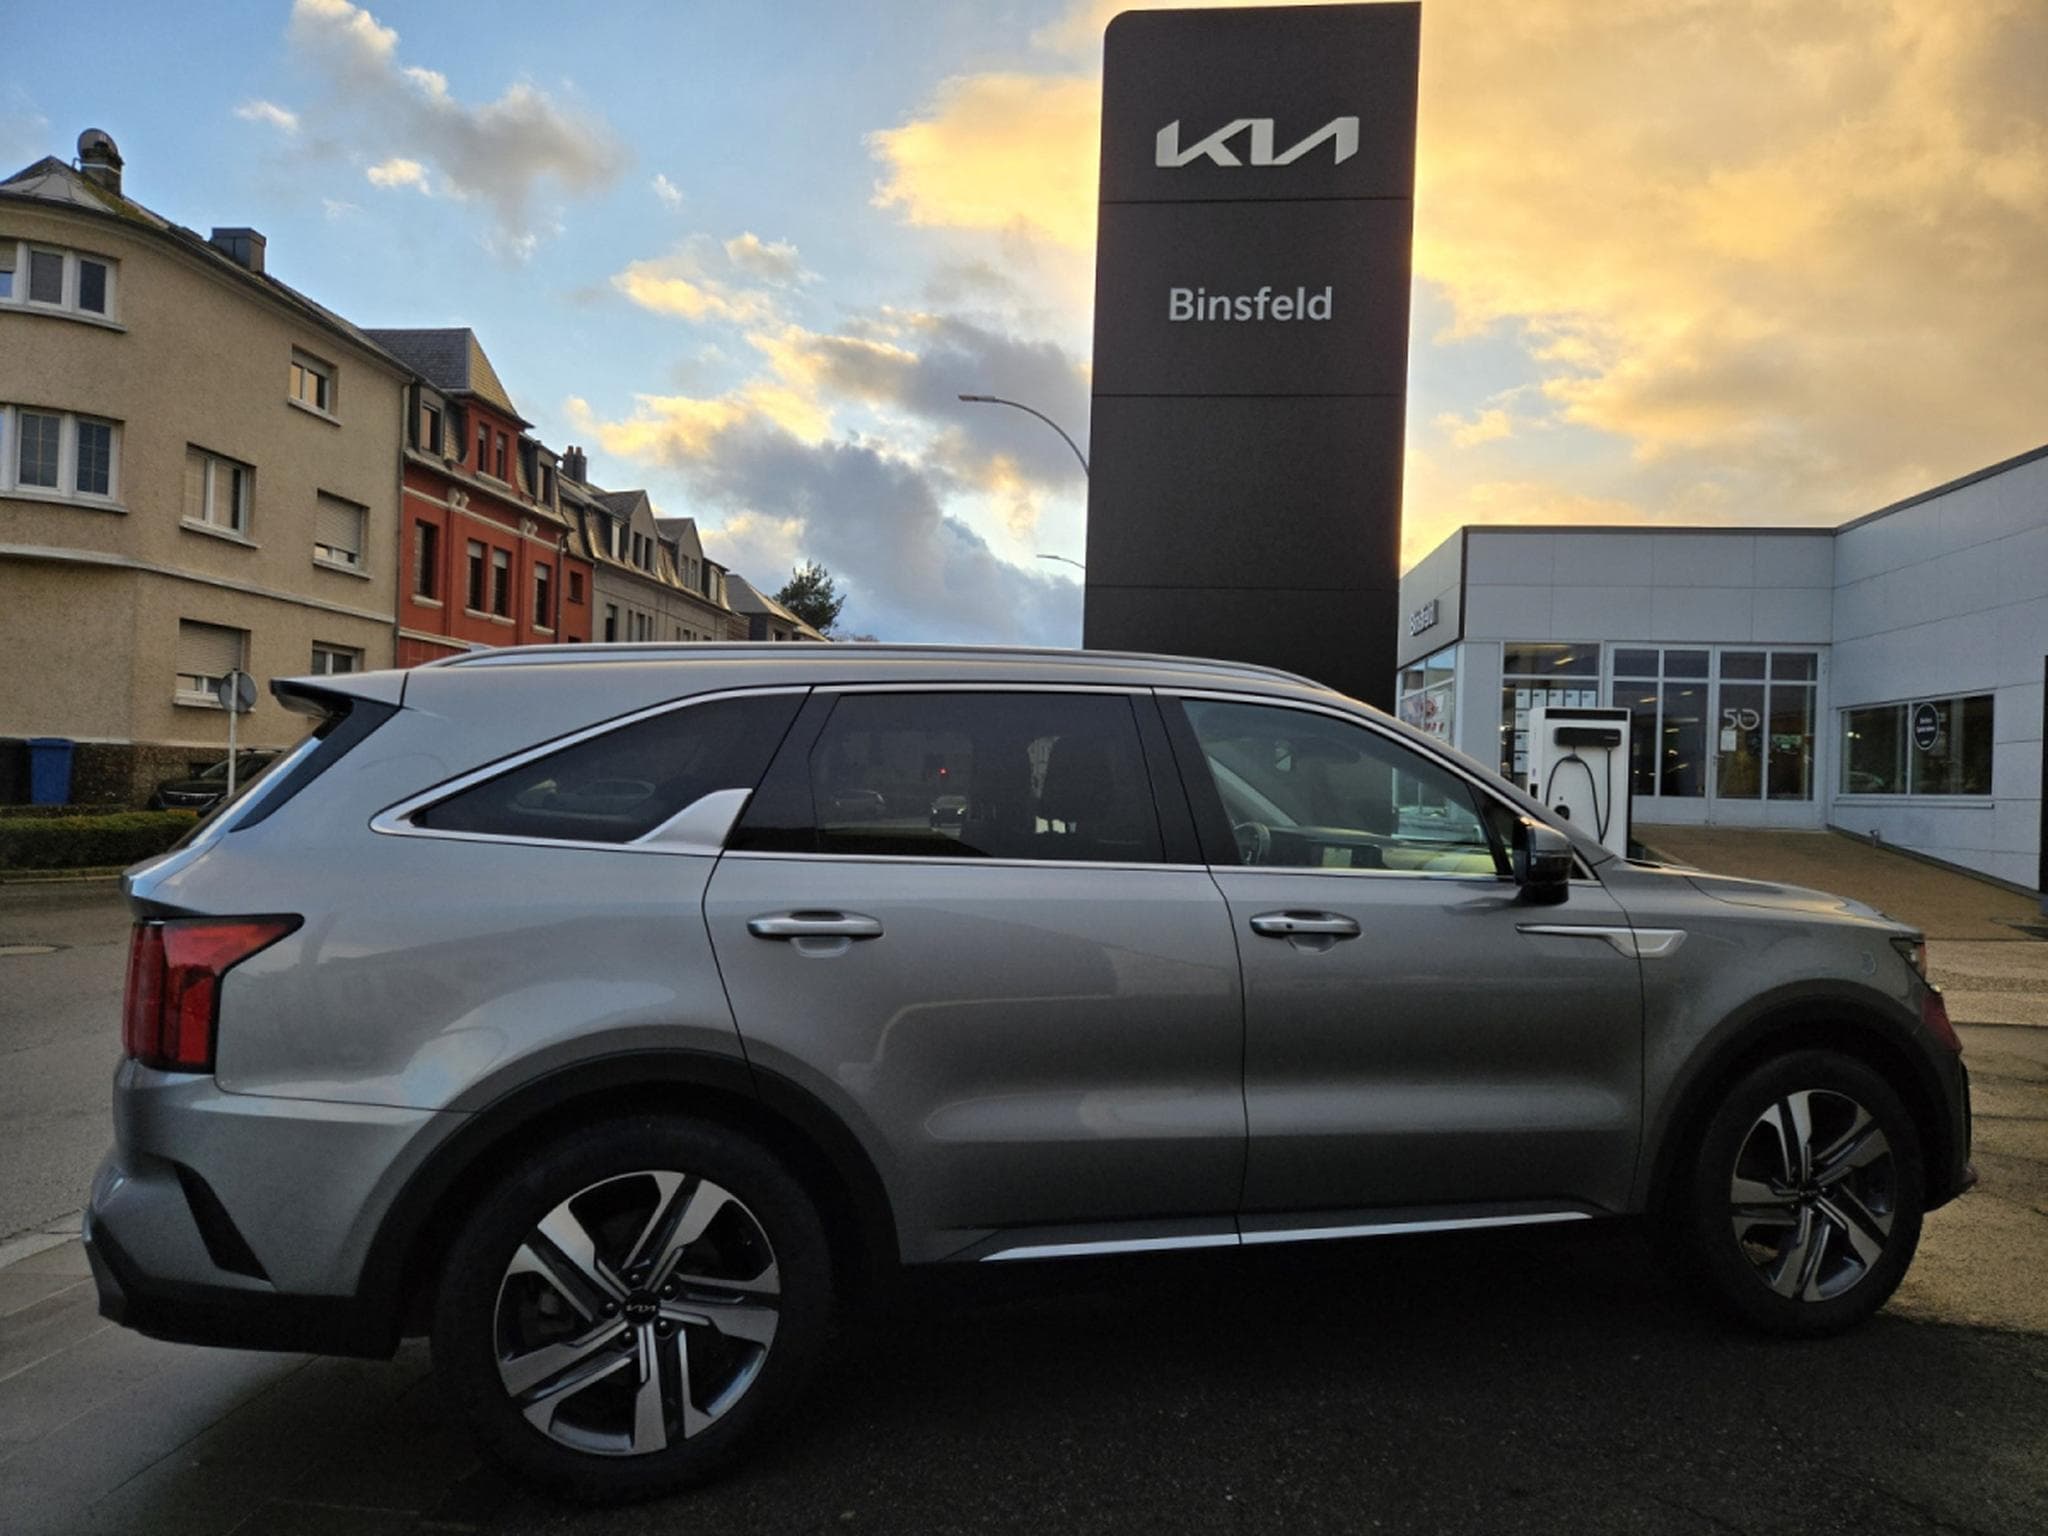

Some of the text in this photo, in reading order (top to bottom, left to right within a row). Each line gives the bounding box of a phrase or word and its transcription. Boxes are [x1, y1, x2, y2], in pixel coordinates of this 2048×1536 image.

[1156, 116, 1359, 167] KIA
[1169, 286, 1333, 321] Binsfeld
[1723, 708, 1760, 730] 50
